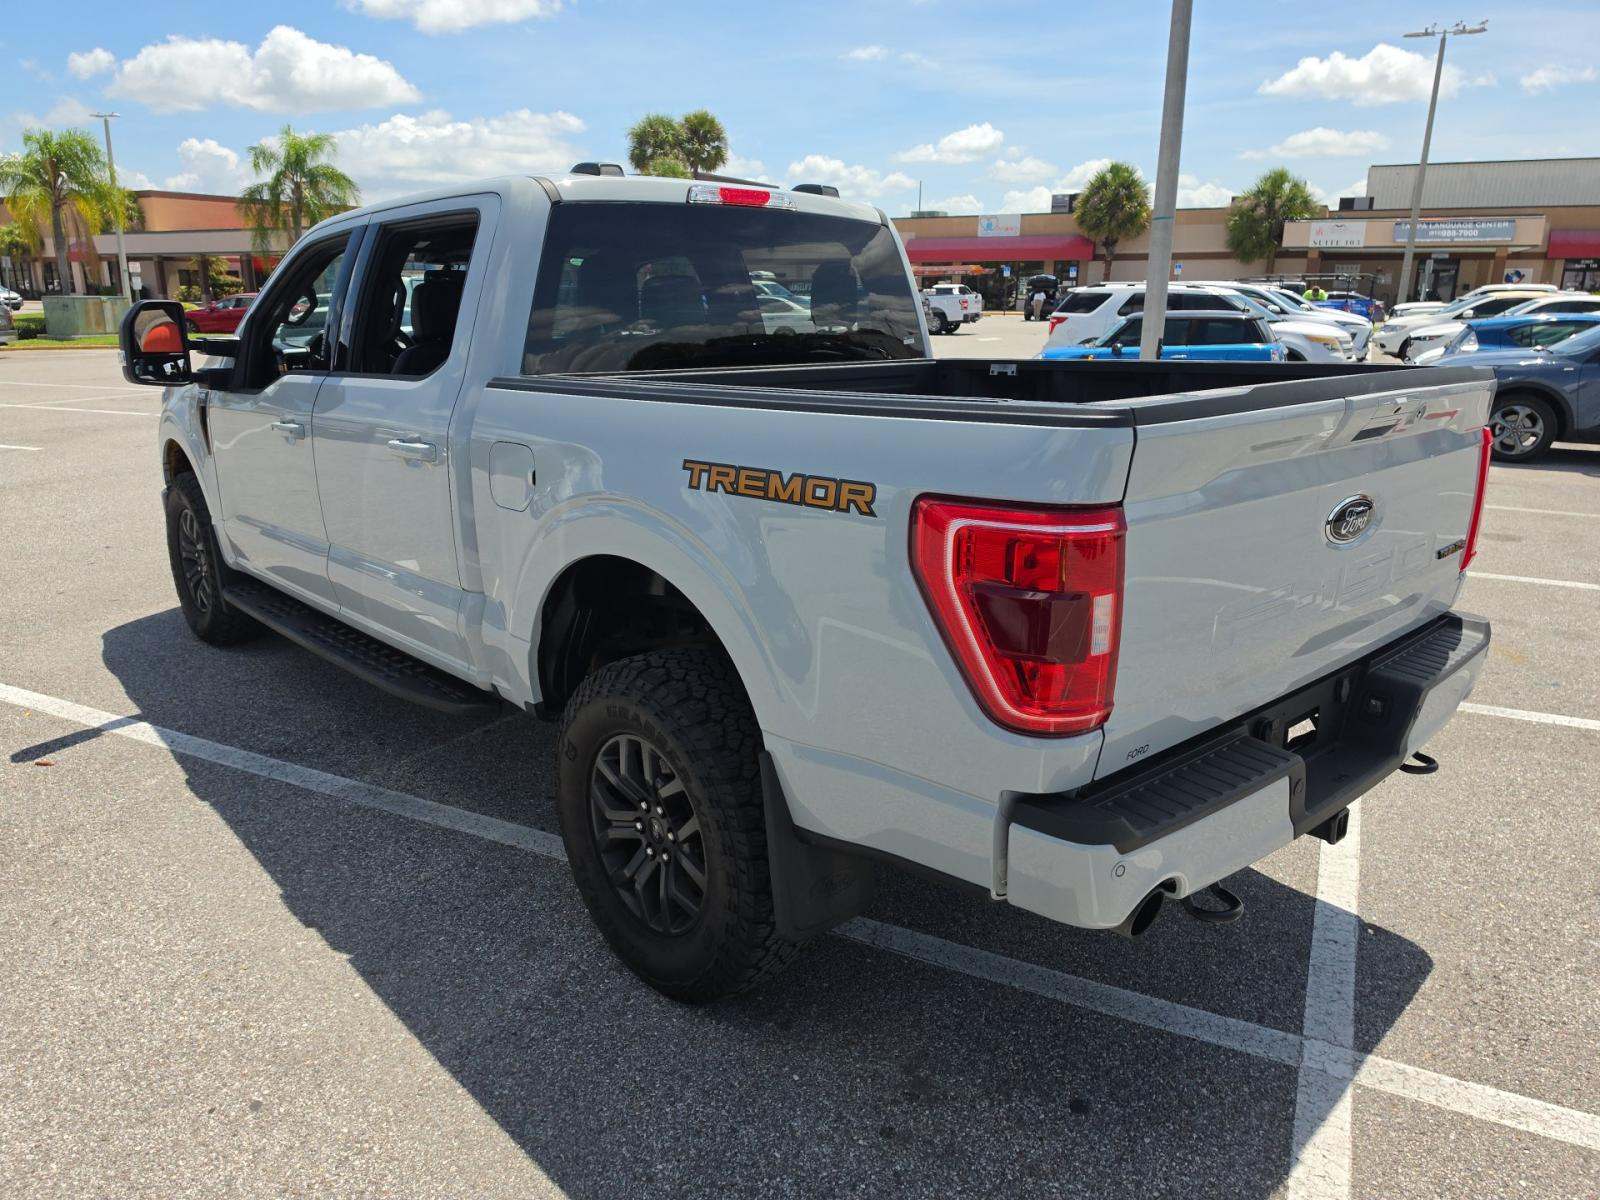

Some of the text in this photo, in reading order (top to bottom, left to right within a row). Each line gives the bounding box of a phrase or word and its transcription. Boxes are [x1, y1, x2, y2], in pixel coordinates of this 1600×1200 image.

[1401, 220, 1510, 230] TAPA LANGUAGE CENTER
[1312, 239, 1341, 247] SUITE
[682, 458, 877, 518] TREMOR
[1126, 743, 1150, 761] FORD
